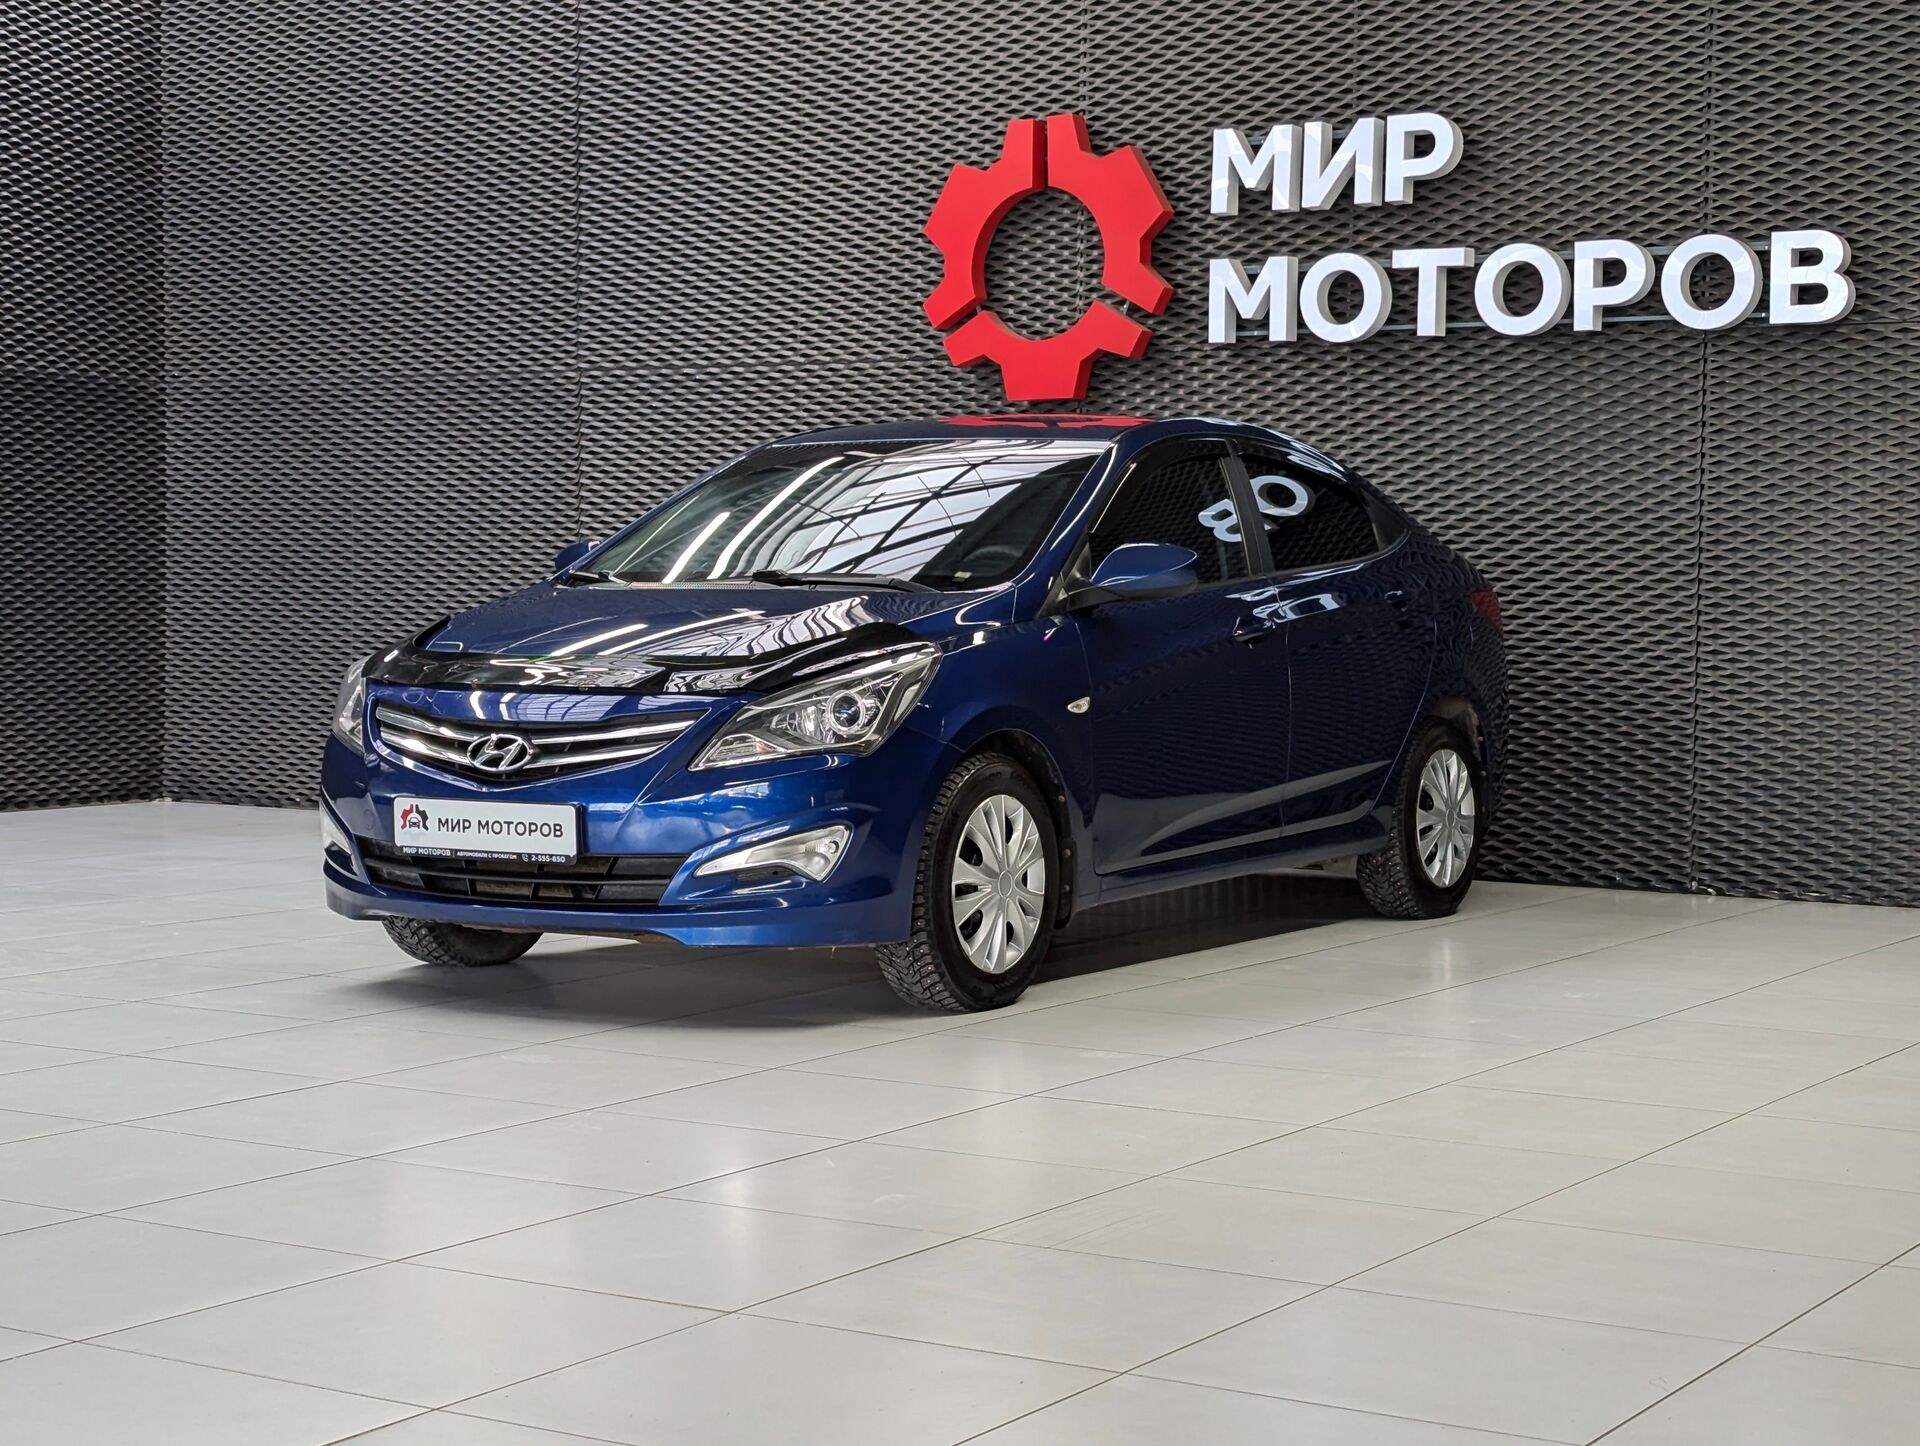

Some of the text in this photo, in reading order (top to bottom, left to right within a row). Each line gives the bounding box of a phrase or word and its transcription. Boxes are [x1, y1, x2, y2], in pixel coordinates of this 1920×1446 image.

[1210, 112, 1464, 216] МИР
[1207, 229, 1857, 344] МОТОРОВ
[402, 846, 418, 855] МИР
[418, 847, 451, 857] МОТОРОВ
[531, 854, 566, 864] 2-555-650
[437, 817, 564, 838] МИР МОТОРОВ
